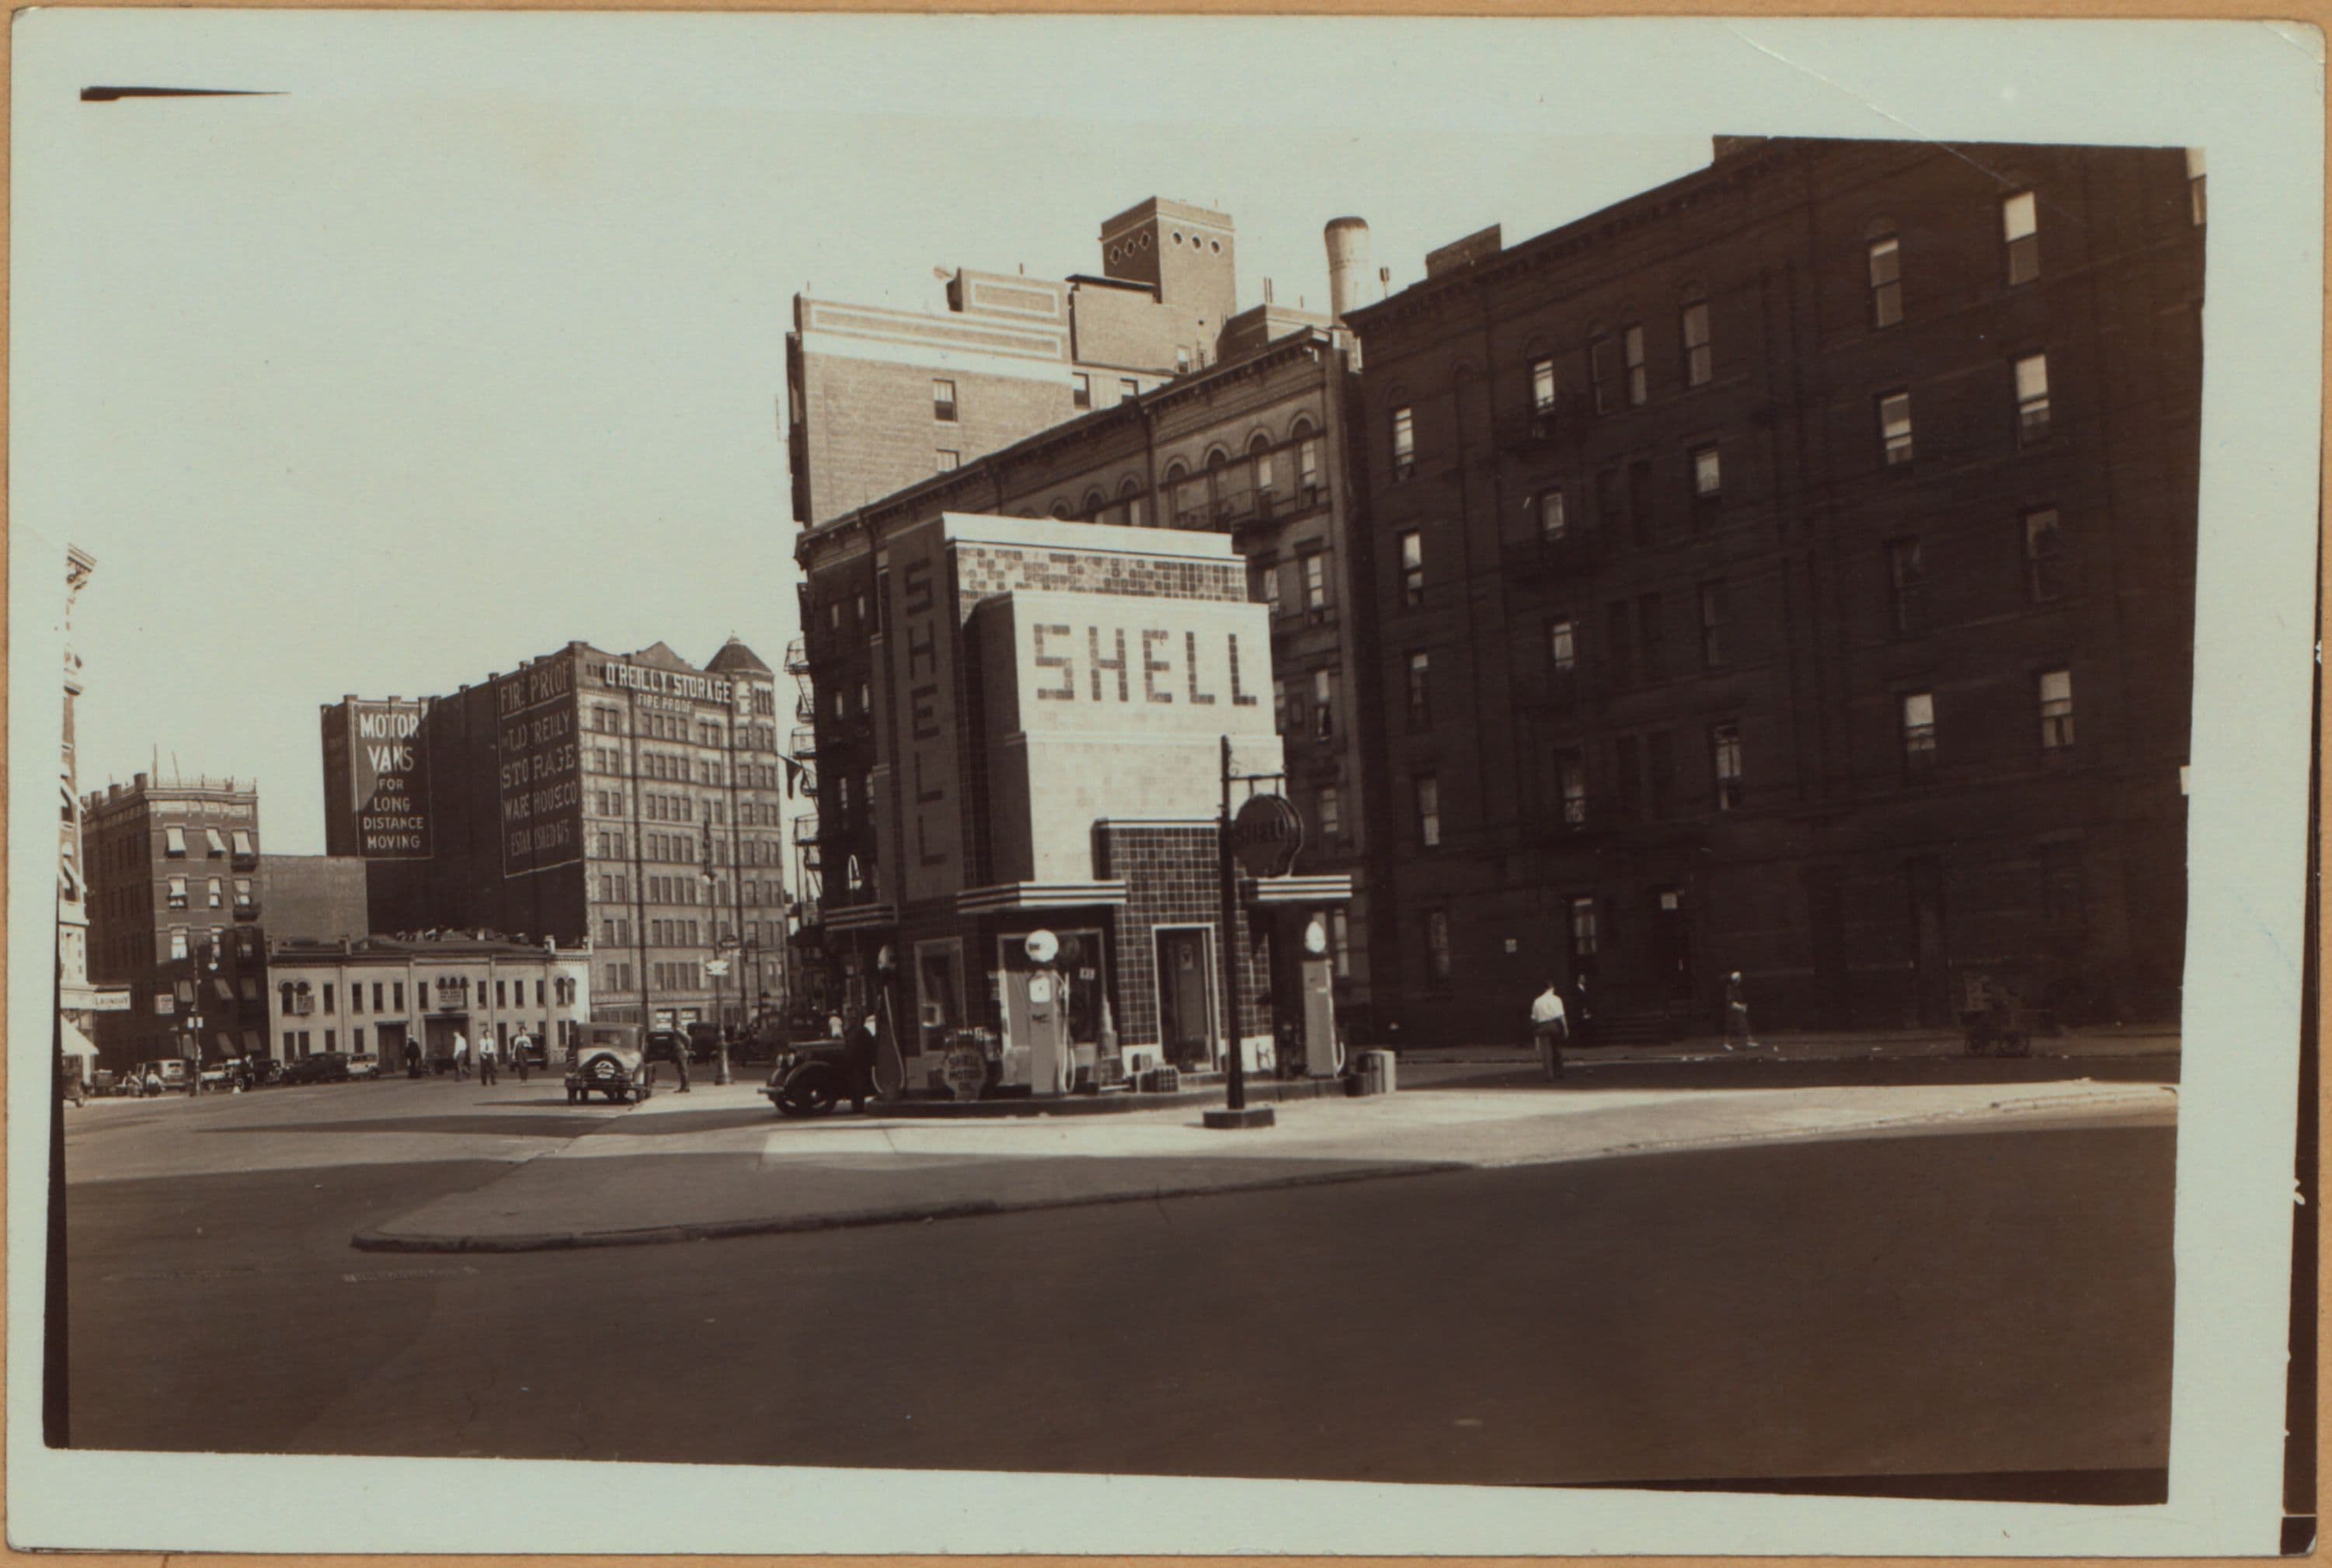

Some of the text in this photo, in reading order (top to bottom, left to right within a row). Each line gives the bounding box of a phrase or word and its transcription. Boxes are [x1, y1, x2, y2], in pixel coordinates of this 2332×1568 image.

[1033, 623, 1258, 706] SHELL
[673, 673, 733, 704] STORAGE
[637, 693, 693, 714] FIRE PROOF
[905, 556, 948, 867] SHELL
[359, 711, 420, 739] MOTOR
[367, 745, 415, 773] VANS
[501, 743, 575, 790] STORAGE
[378, 778, 404, 791] FOR
[373, 796, 411, 812] LONG
[363, 816, 424, 831] DISTANCE
[367, 834, 421, 850] MOVING
